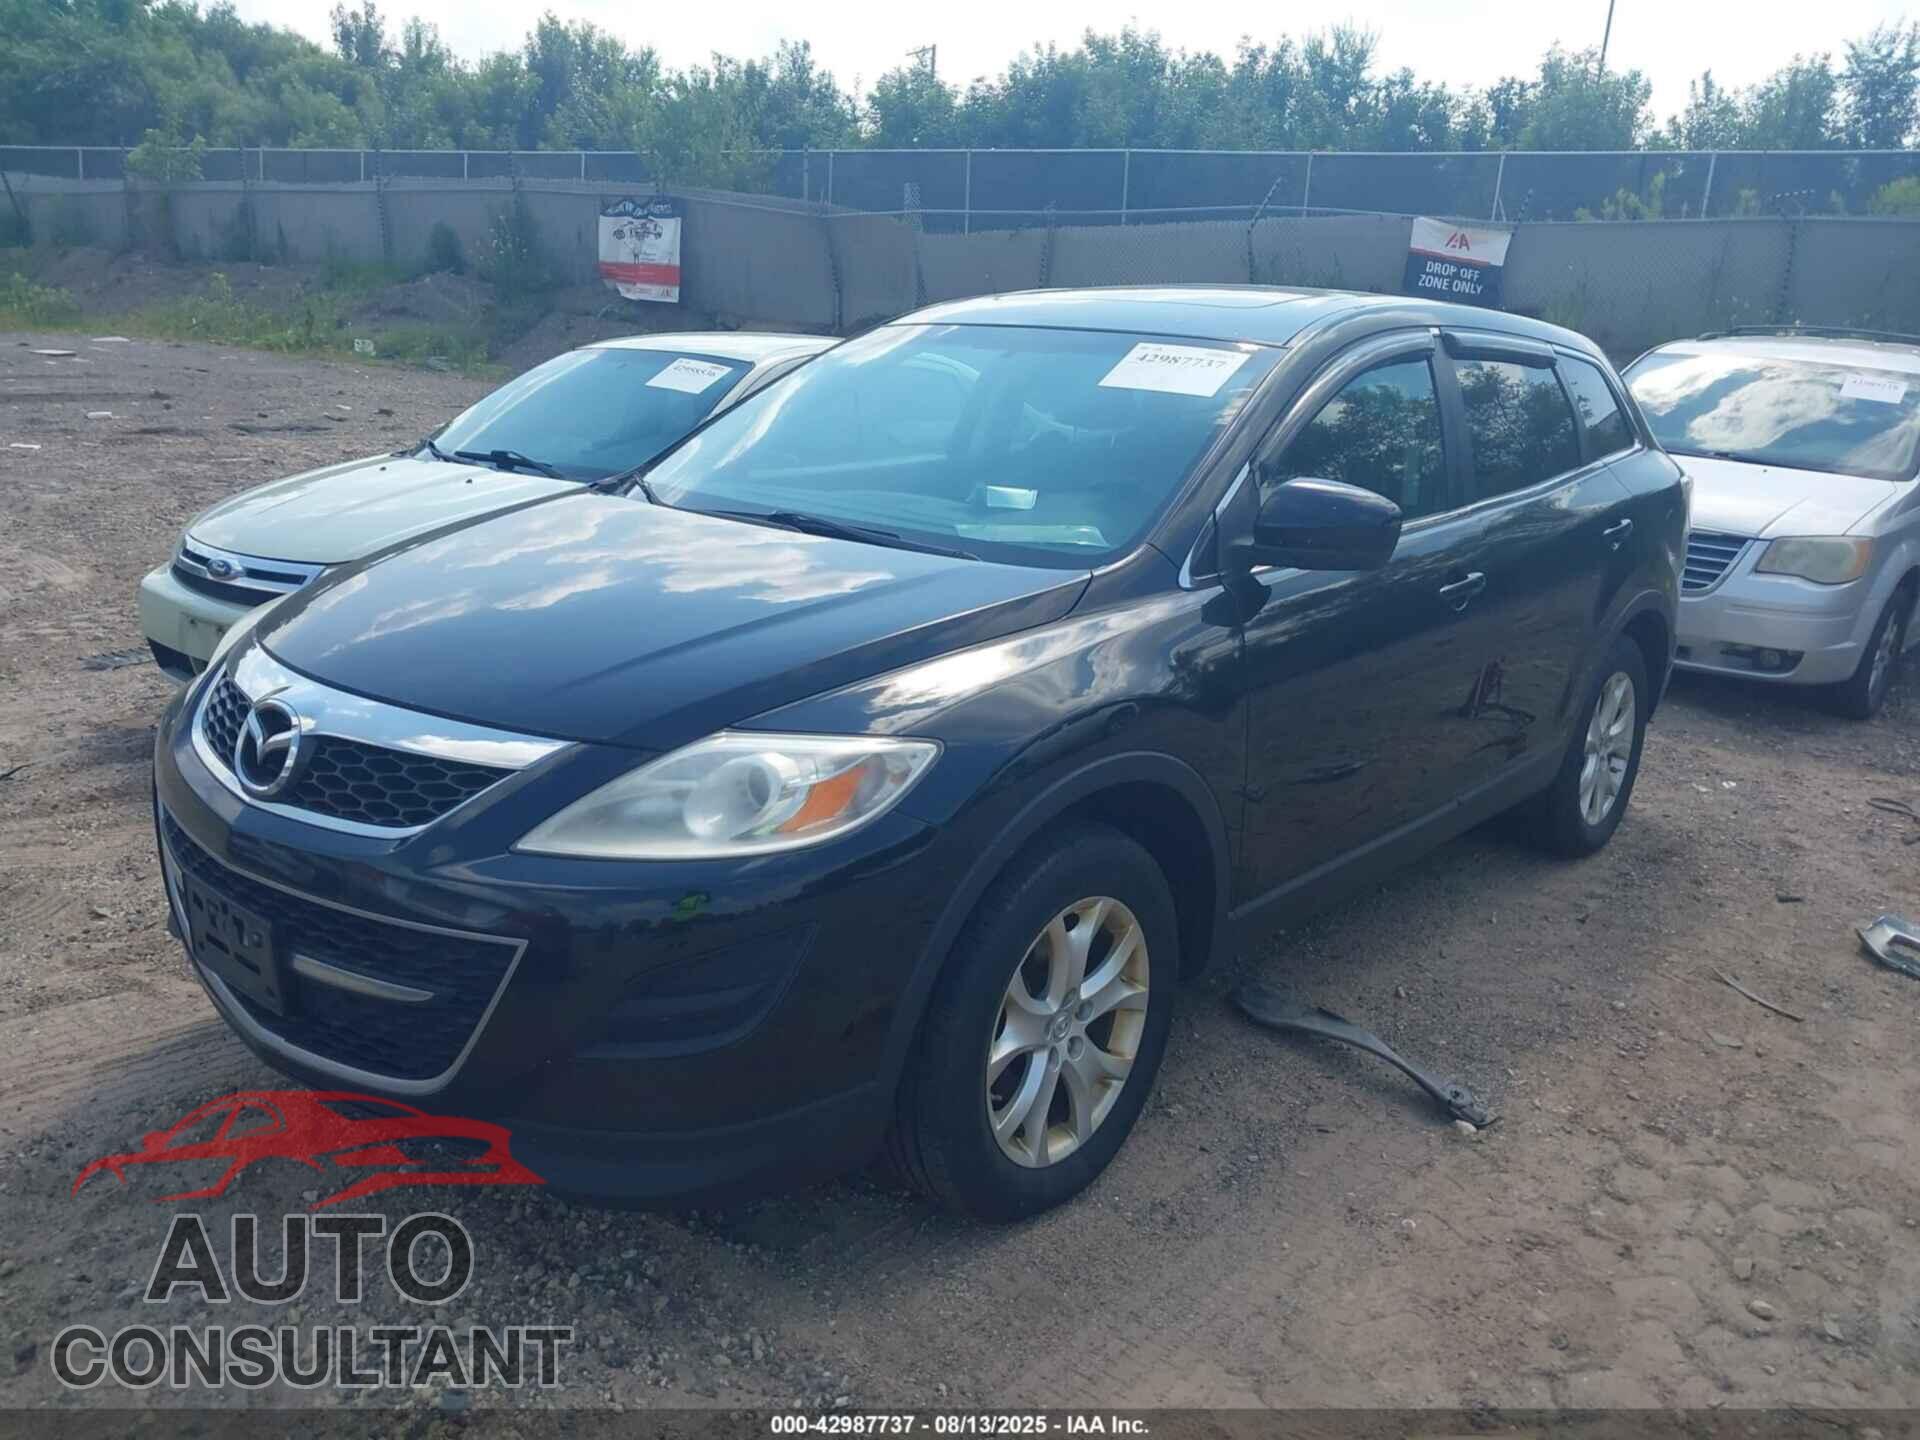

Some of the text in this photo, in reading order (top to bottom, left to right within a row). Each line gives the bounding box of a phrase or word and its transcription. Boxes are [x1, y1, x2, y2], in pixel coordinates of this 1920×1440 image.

[1426, 260, 1481, 283] DROP OFF
[1418, 273, 1483, 295] ZONE ONLY
